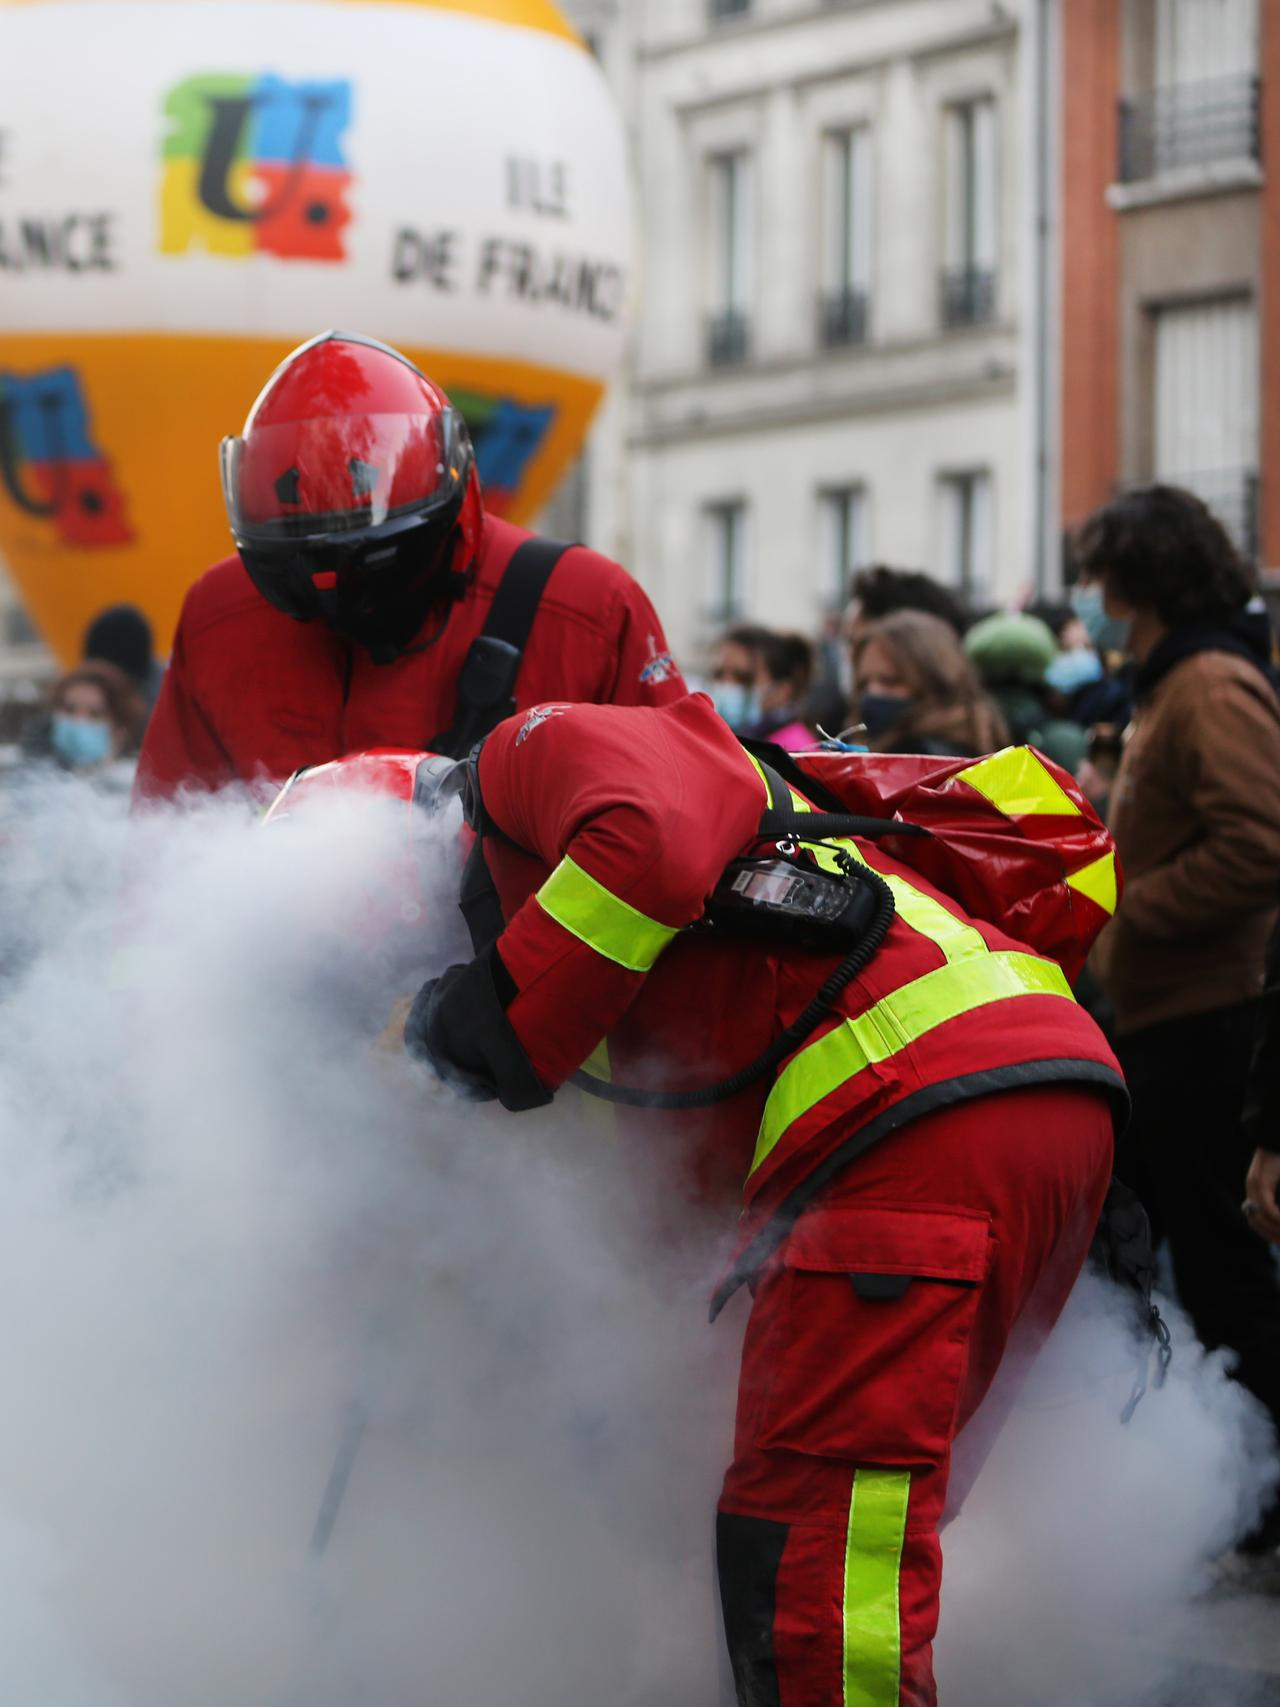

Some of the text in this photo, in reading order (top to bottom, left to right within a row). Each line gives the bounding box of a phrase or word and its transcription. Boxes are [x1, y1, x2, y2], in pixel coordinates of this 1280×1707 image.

[506, 155, 570, 217] ILE
[393, 227, 624, 321] DE FRANC
